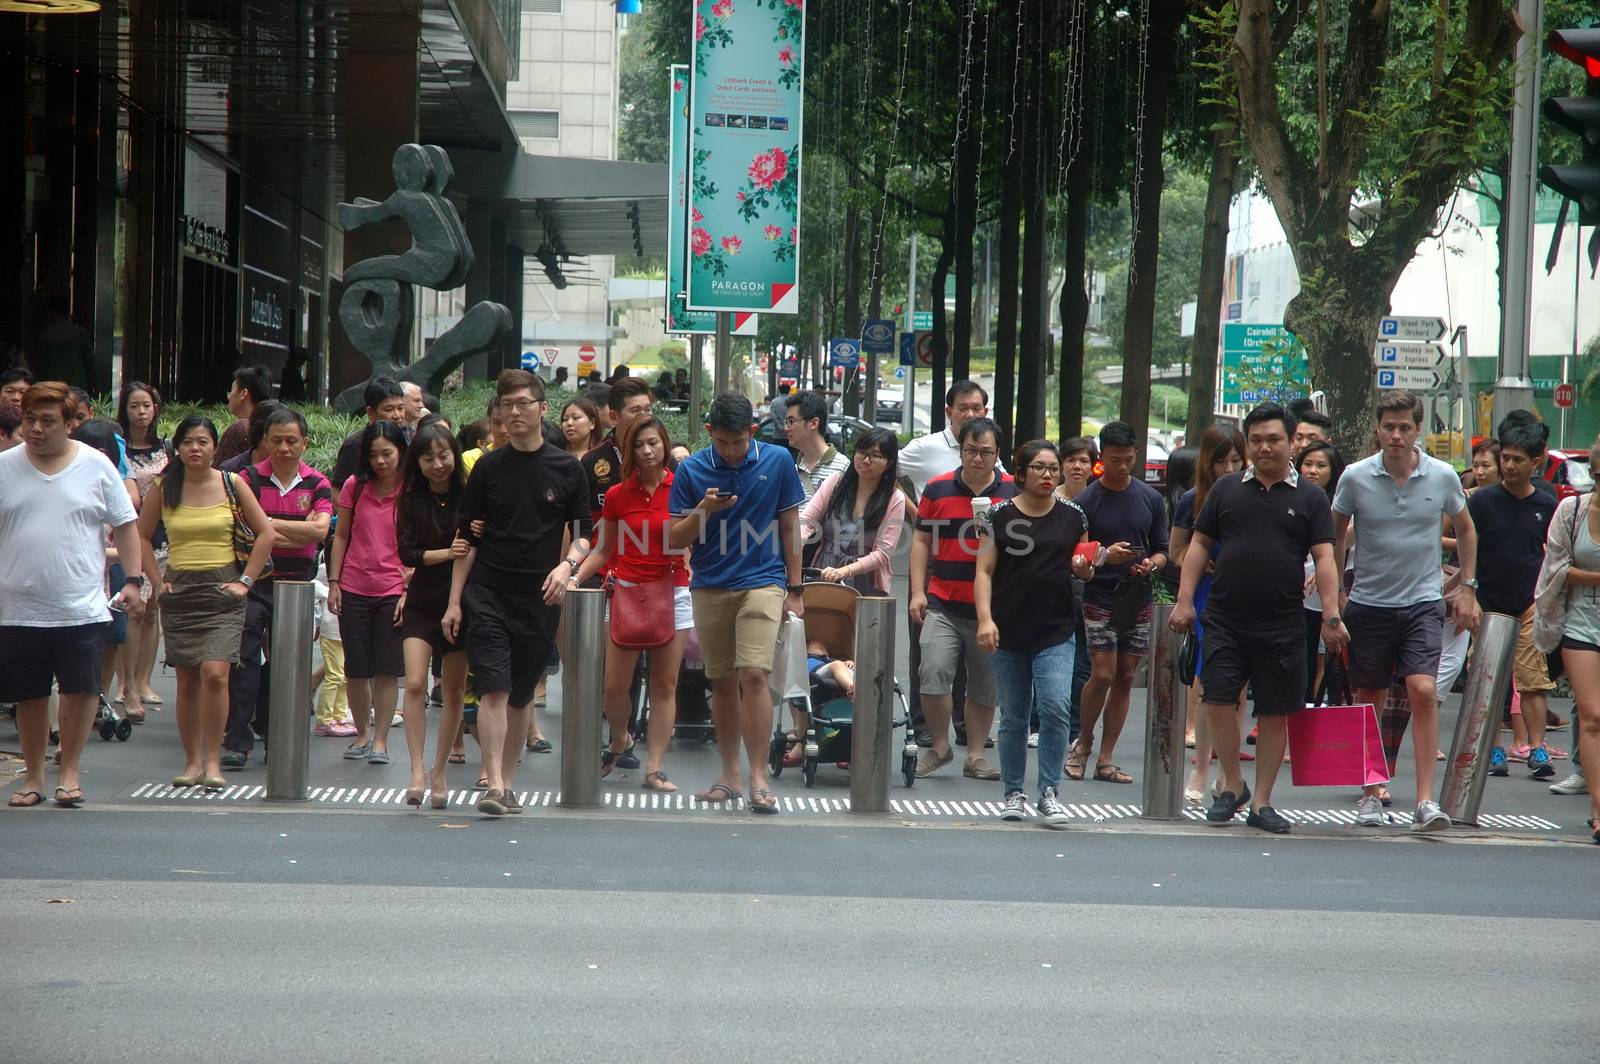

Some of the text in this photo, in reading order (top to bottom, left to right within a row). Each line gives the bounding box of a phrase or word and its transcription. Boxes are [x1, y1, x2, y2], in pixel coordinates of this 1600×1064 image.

[712, 280, 765, 291] PARAGON
[1247, 327, 1277, 336] Cairnhill
[1405, 329, 1430, 337] Orchard
[1400, 346, 1422, 355] Holiday
[1556, 390, 1572, 400] STO
